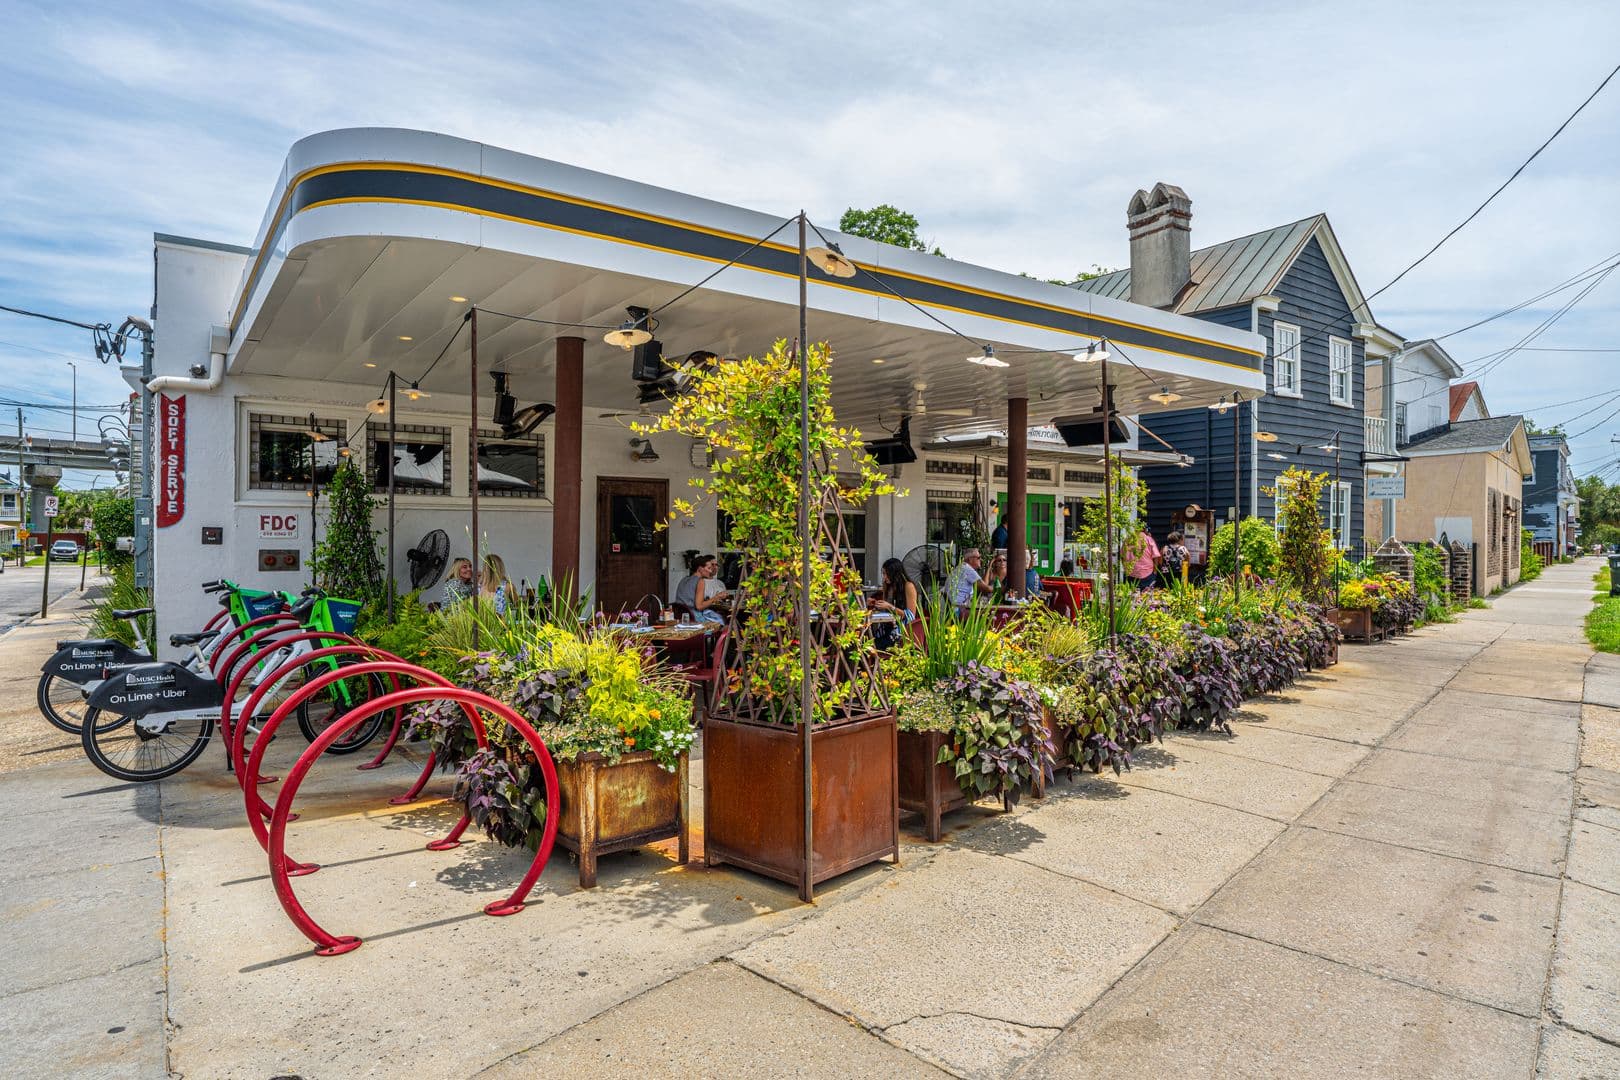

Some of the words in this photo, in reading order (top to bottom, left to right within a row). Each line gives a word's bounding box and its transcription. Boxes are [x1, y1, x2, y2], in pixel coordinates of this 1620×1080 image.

[168, 404, 179, 450] SOFT
[167, 454, 179, 513] SERVE
[260, 515, 297, 531] FDC
[60, 663, 74, 671] On
[74, 662, 97, 671] Lime
[104, 661, 125, 670] Uber
[156, 673, 175, 681] Health
[110, 695, 127, 704] On
[127, 692, 154, 702] Lime
[162, 689, 187, 699] Uber
